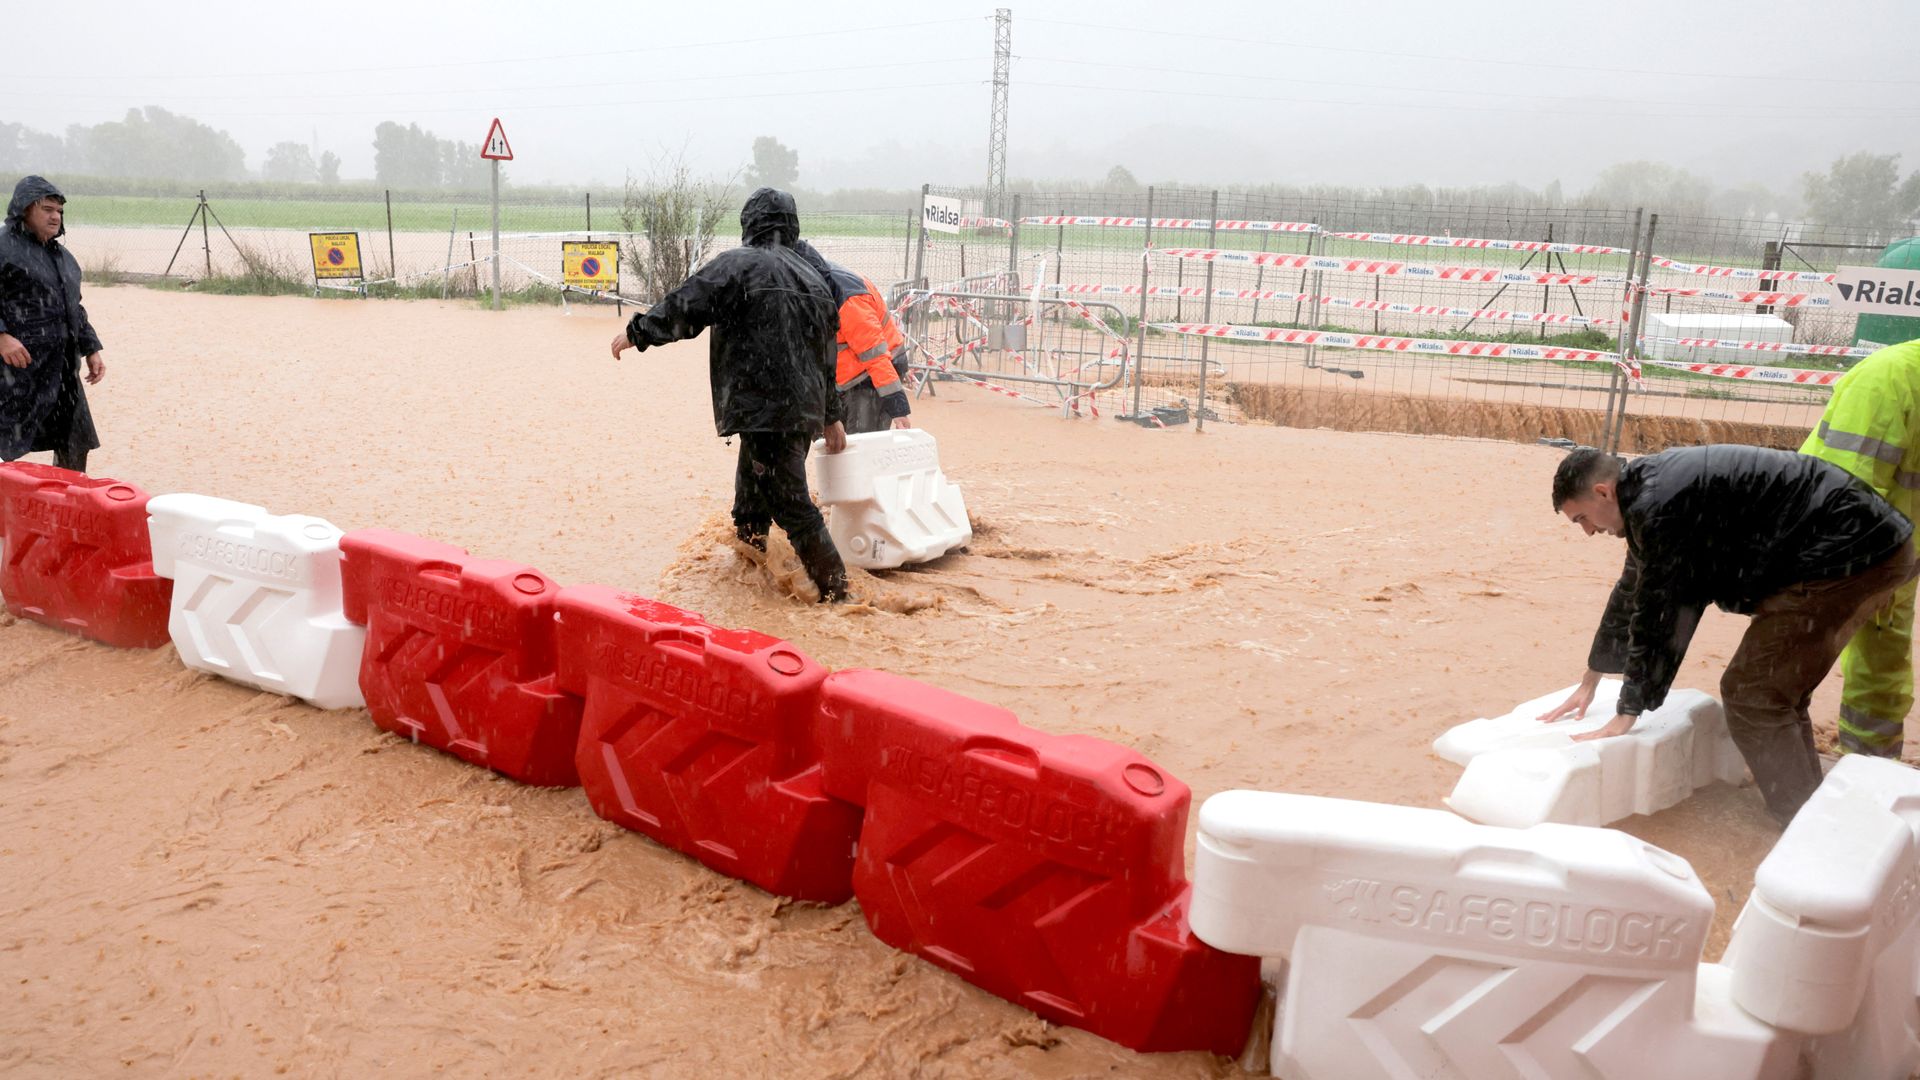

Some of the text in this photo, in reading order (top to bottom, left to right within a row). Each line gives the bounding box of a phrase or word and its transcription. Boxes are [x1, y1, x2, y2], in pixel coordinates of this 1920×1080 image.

[930, 205, 959, 226] Rialsa
[1318, 260, 1340, 268] Rialsa
[1411, 267, 1434, 275] Rialsa
[1508, 273, 1531, 281] Rialsa
[1329, 336, 1351, 344] Rialsa
[1421, 342, 1444, 351] Rialsa
[1516, 347, 1539, 356] Rialsa
[1763, 370, 1789, 379] Rialsa
